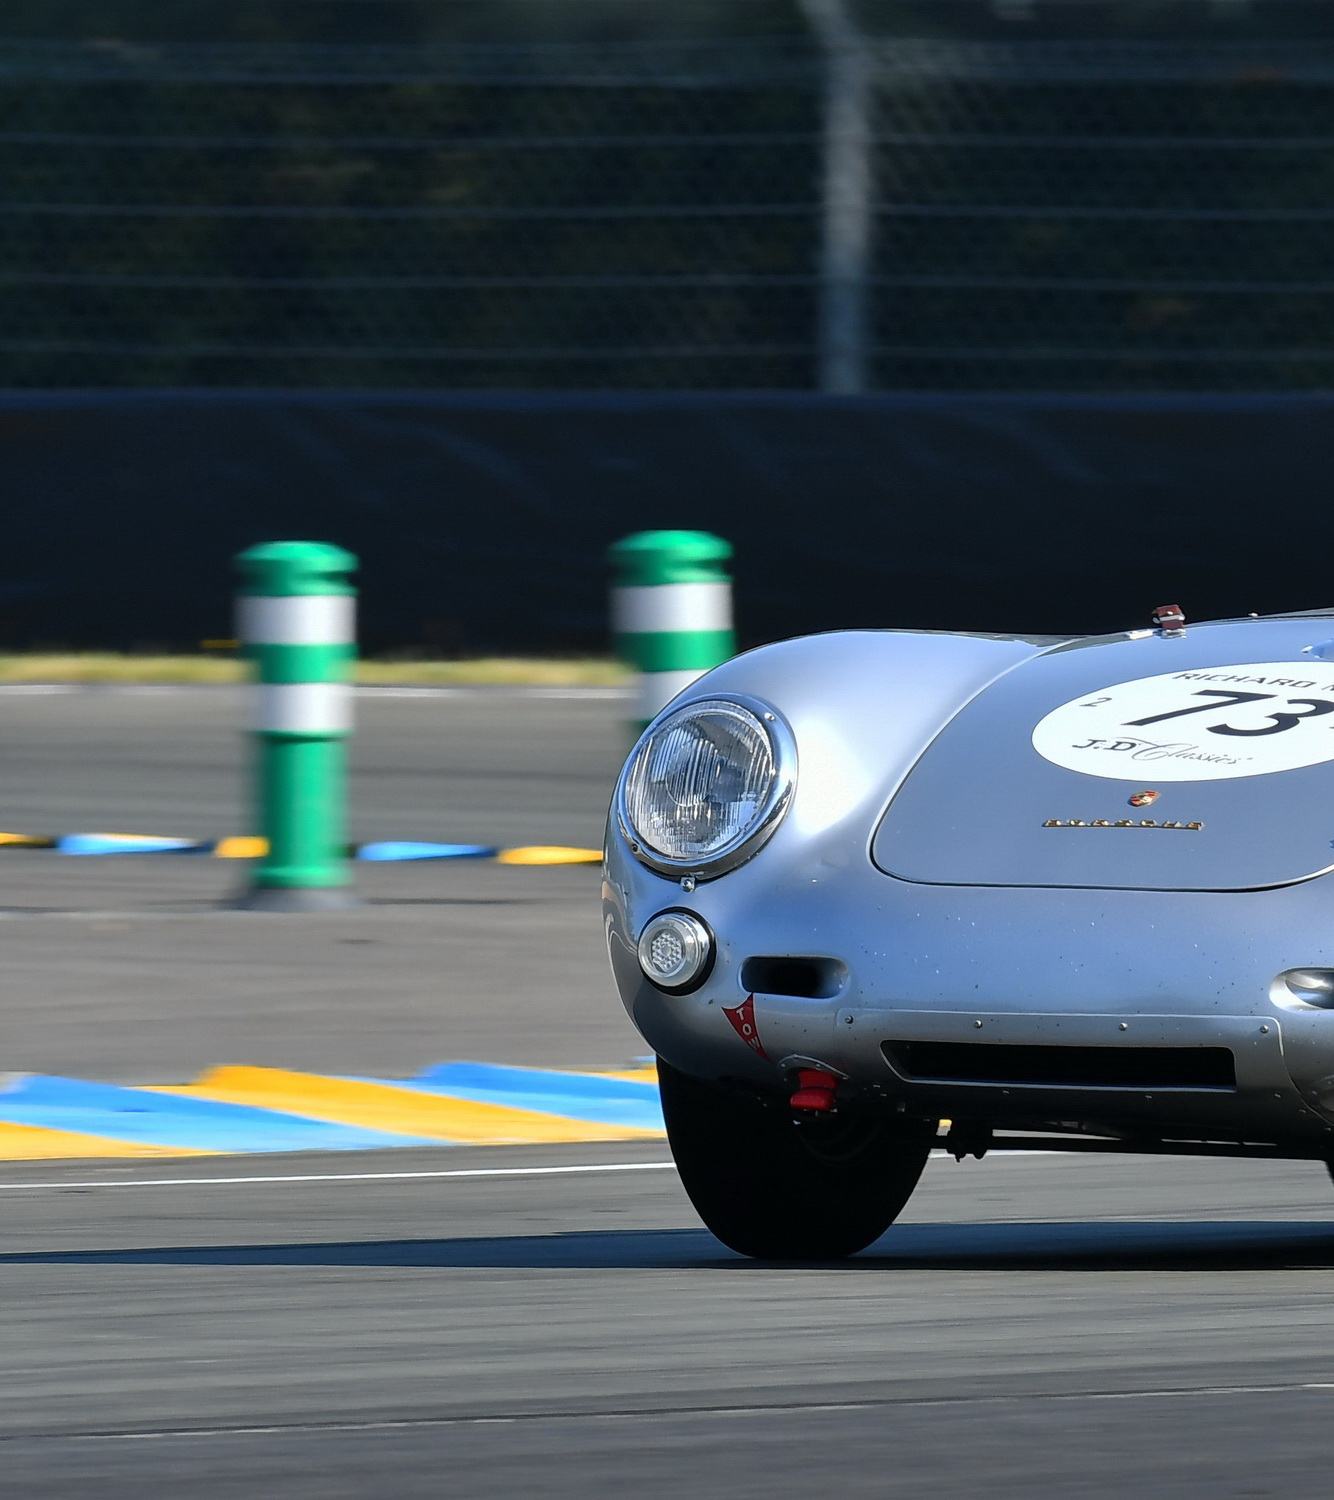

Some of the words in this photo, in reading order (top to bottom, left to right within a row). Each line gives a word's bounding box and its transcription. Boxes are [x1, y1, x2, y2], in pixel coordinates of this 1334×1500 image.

[1172, 672, 1317, 689] RICHARD
[1115, 736, 1241, 765] Classics
[735, 1007, 761, 1050] TOW
